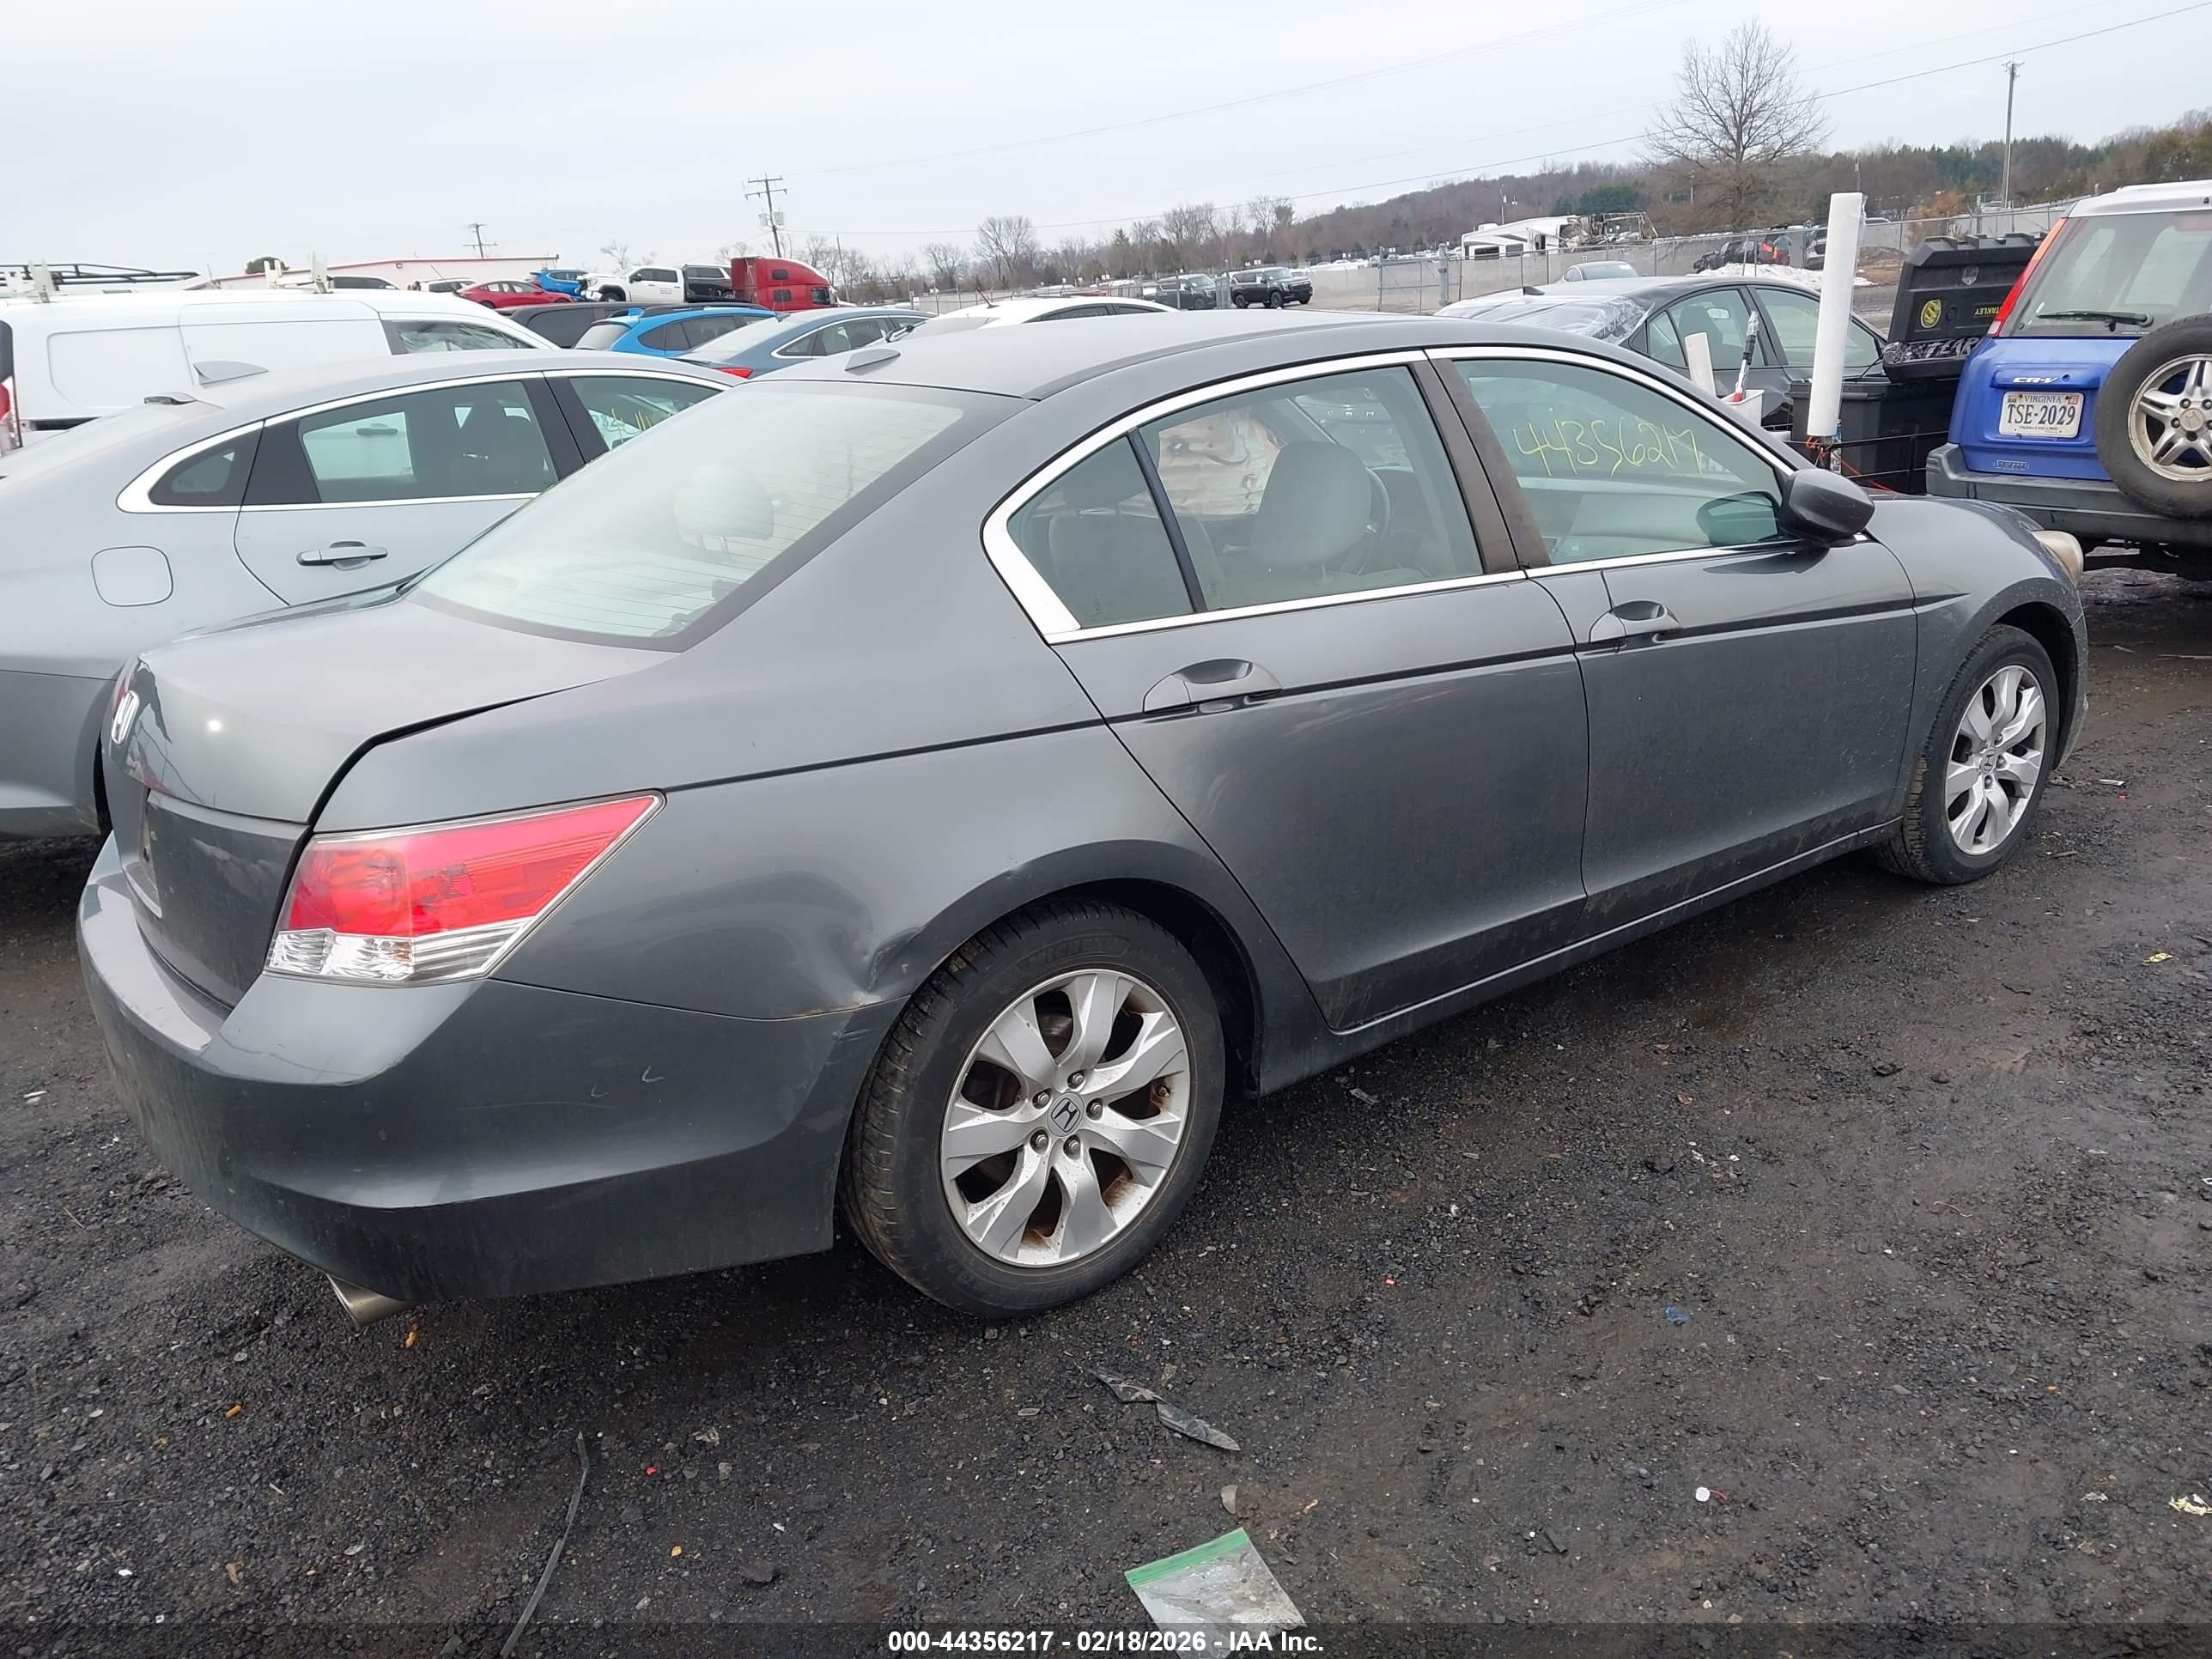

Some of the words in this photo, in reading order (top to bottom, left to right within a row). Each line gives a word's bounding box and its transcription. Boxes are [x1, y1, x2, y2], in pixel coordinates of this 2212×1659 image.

[1974, 307, 2002, 316] TANLEY
[2024, 395, 2062, 404] VIRGINIA
[2007, 404, 2076, 425] TSE-2029
[1512, 417, 1704, 478] 44356217
